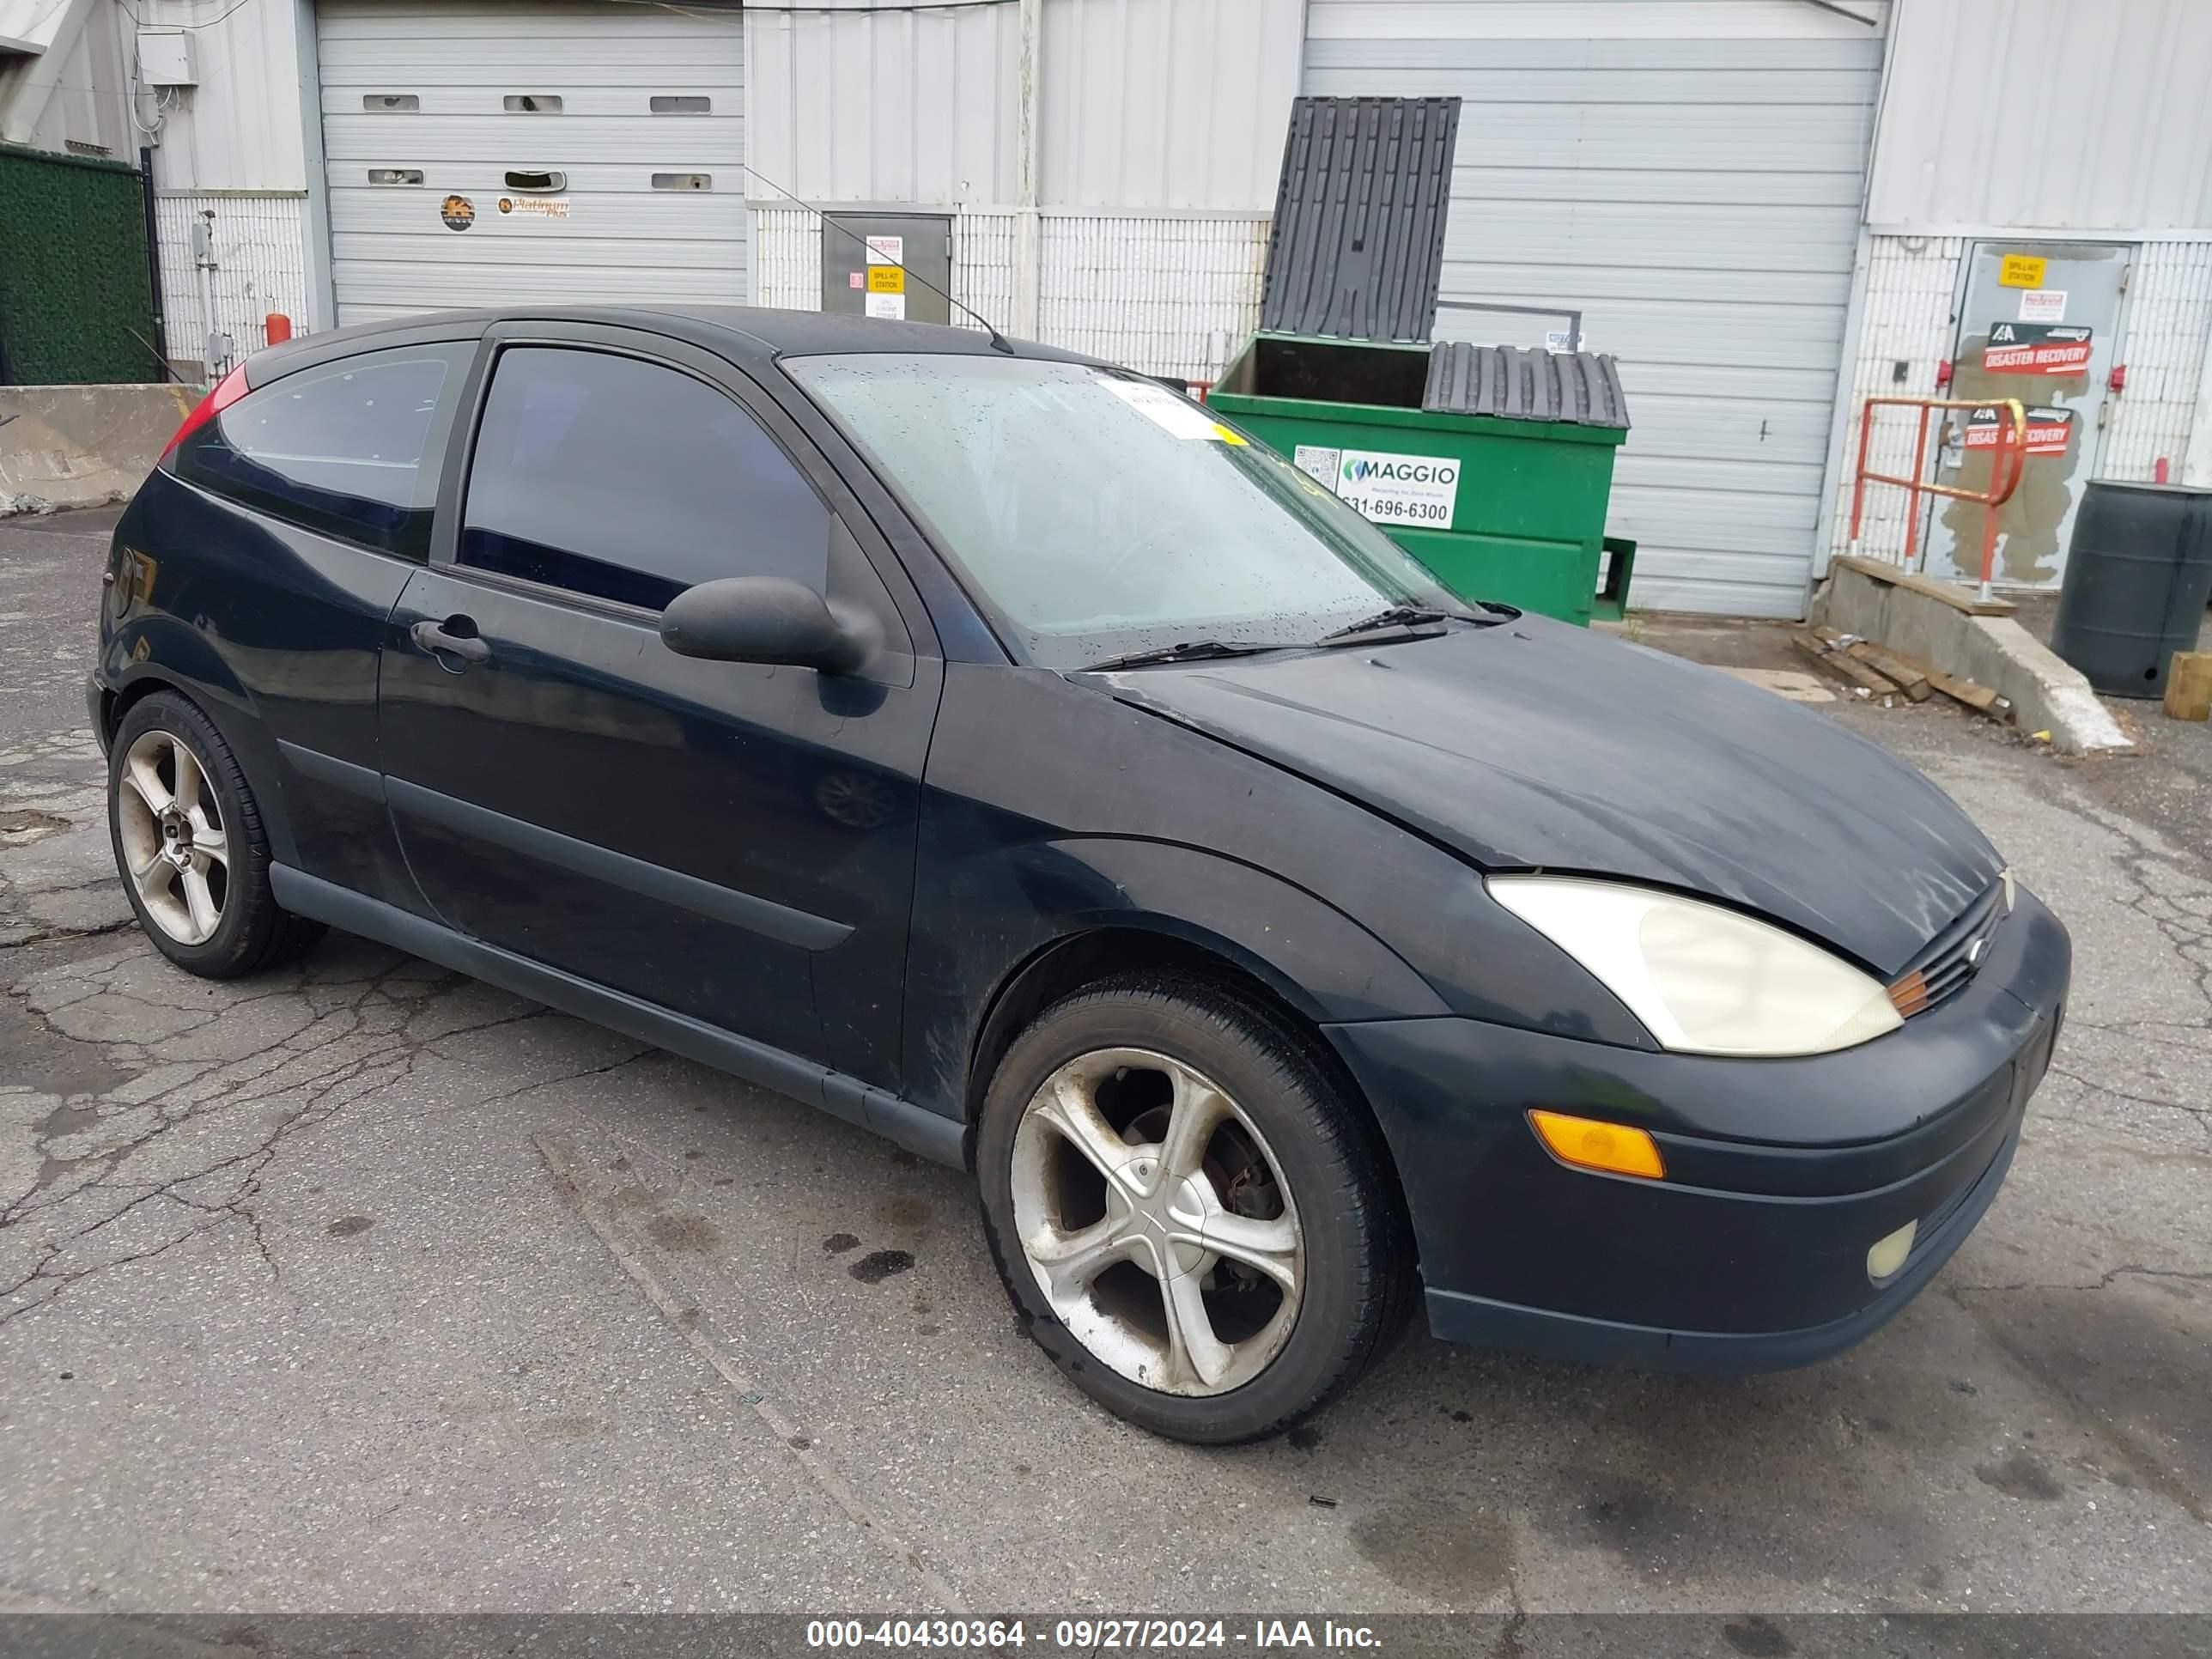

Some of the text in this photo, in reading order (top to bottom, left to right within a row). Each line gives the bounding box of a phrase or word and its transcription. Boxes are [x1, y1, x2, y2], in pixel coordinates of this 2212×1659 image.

[514, 198, 569, 210] Platinum
[2008, 271, 2036, 282] STATION
[875, 281, 898, 289] STATION
[1985, 347, 2088, 368] DISASTER RECOVERY
[1360, 460, 1455, 485] MAGGIO
